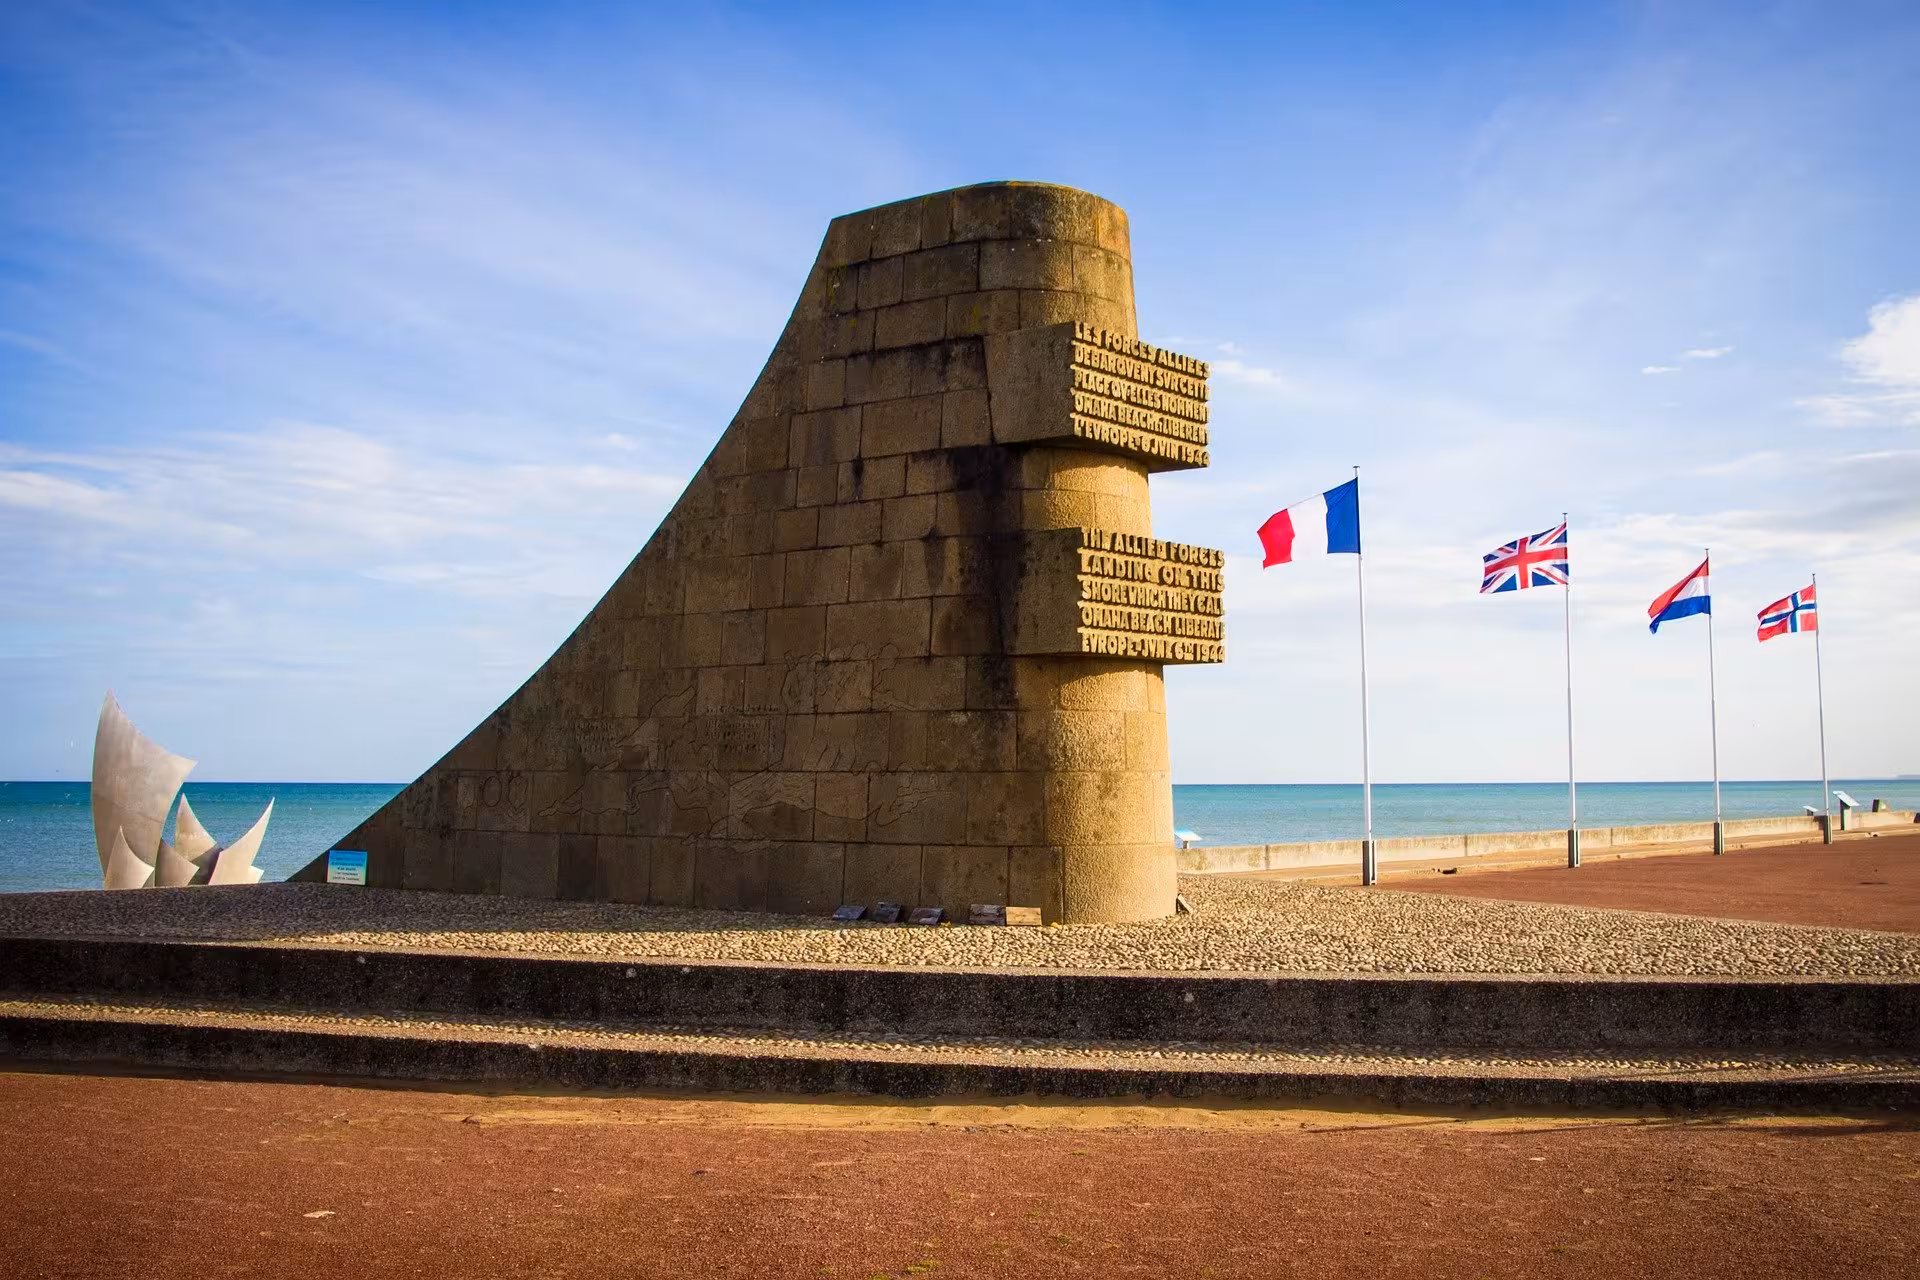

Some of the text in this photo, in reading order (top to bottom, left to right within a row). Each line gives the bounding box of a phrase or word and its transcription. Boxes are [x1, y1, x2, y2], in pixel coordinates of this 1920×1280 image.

[1106, 330, 1156, 362] FORCES
[1160, 347, 1210, 378] ALLIEES
[1075, 368, 1110, 394] PLAGE
[1156, 370, 1178, 392] SVR
[1075, 393, 1116, 421] OMAHA
[1118, 406, 1155, 430] BEACH
[1151, 437, 1178, 461] JVIN
[1182, 444, 1210, 466] 1944
[1115, 532, 1166, 559] ALLIED
[1170, 542, 1224, 566] FORCES
[1081, 552, 1224, 591] LANDING ON THIS
[1082, 580, 1128, 603] SHORE
[1128, 585, 1166, 607] WHICH
[1167, 590, 1195, 611] THEY
[1082, 606, 1130, 630] OMAHA
[1131, 609, 1172, 634] BEACH
[1142, 637, 1172, 659] JVNE
[1196, 643, 1224, 662] 1944
